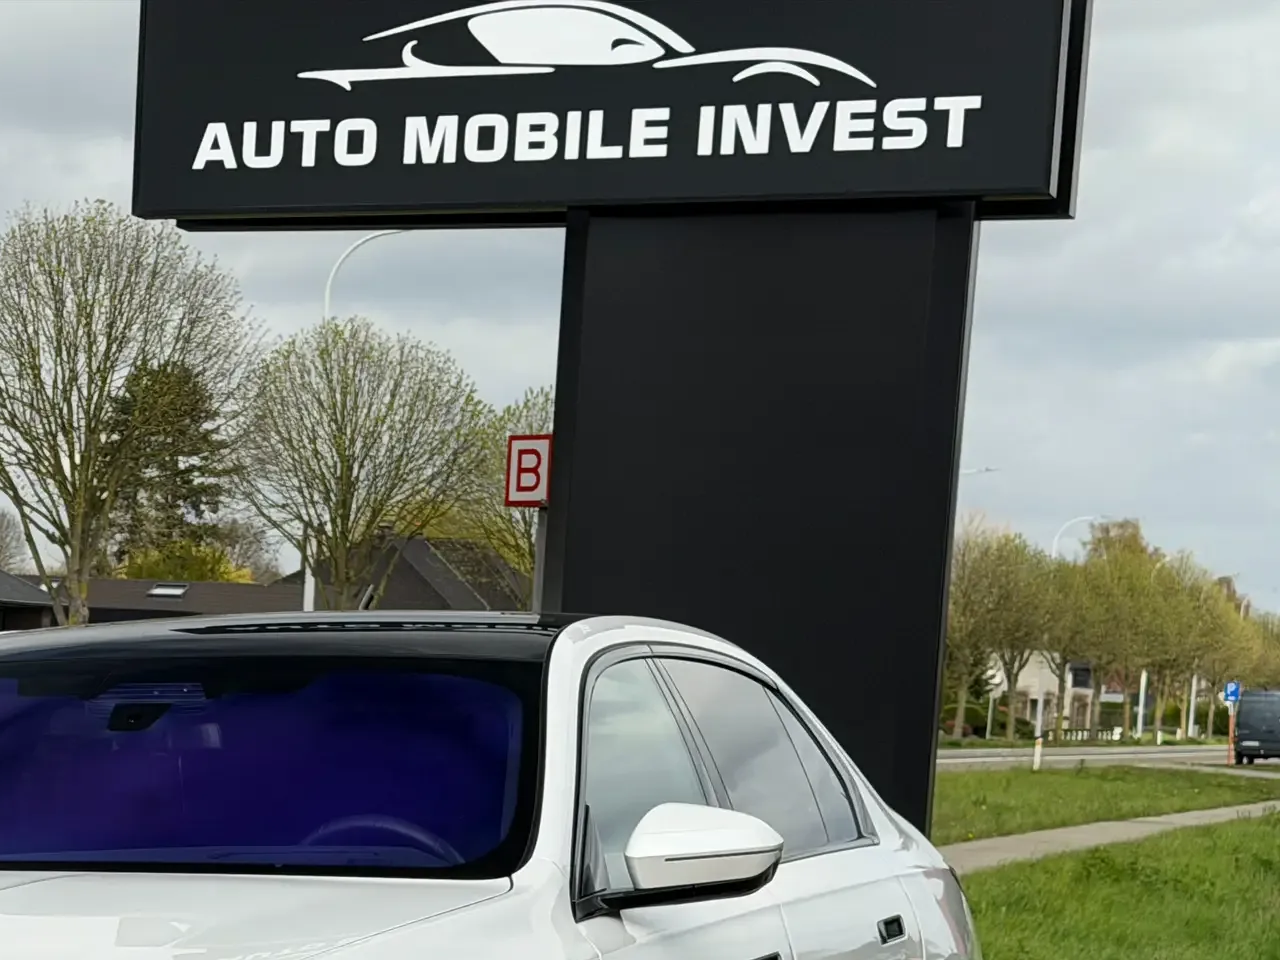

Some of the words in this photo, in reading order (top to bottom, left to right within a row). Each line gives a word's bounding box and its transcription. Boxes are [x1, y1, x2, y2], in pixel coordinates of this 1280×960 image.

[191, 117, 378, 170] AUTO
[402, 107, 671, 165] MOBILE
[696, 95, 982, 156] INVEST
[515, 448, 542, 493] B
